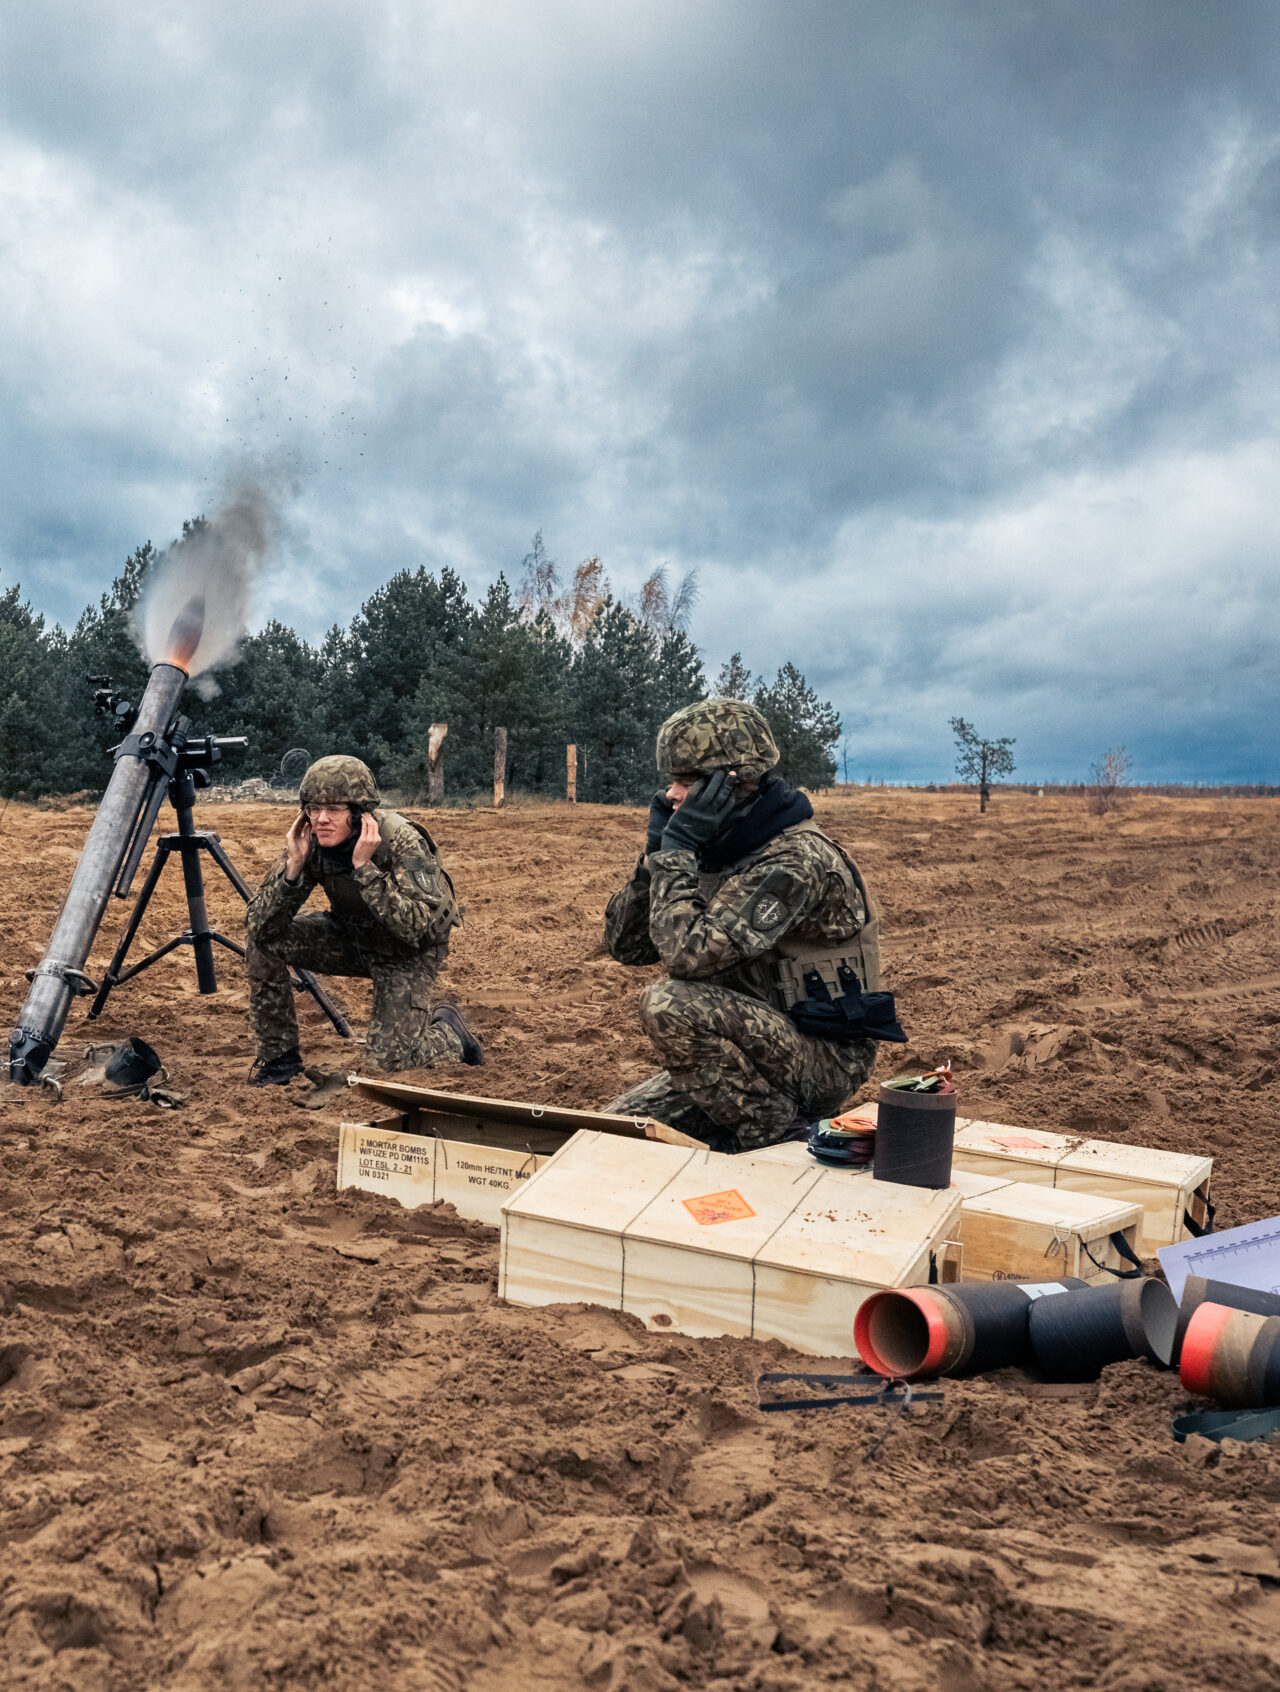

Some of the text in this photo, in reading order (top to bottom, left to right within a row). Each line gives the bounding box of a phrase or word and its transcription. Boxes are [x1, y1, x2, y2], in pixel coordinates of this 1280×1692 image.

[366, 1139, 397, 1152] MORTAR
[399, 1144, 427, 1156] BOMBS
[359, 1147, 429, 1165] W/FUZE PD DM111S
[359, 1158, 374, 1167] LOT
[375, 1161, 389, 1170] ESL
[456, 1160, 482, 1172] 120mm
[484, 1165, 513, 1177] HE/TNT
[359, 1168, 389, 1180] UN 0321
[468, 1176, 487, 1185] WGT
